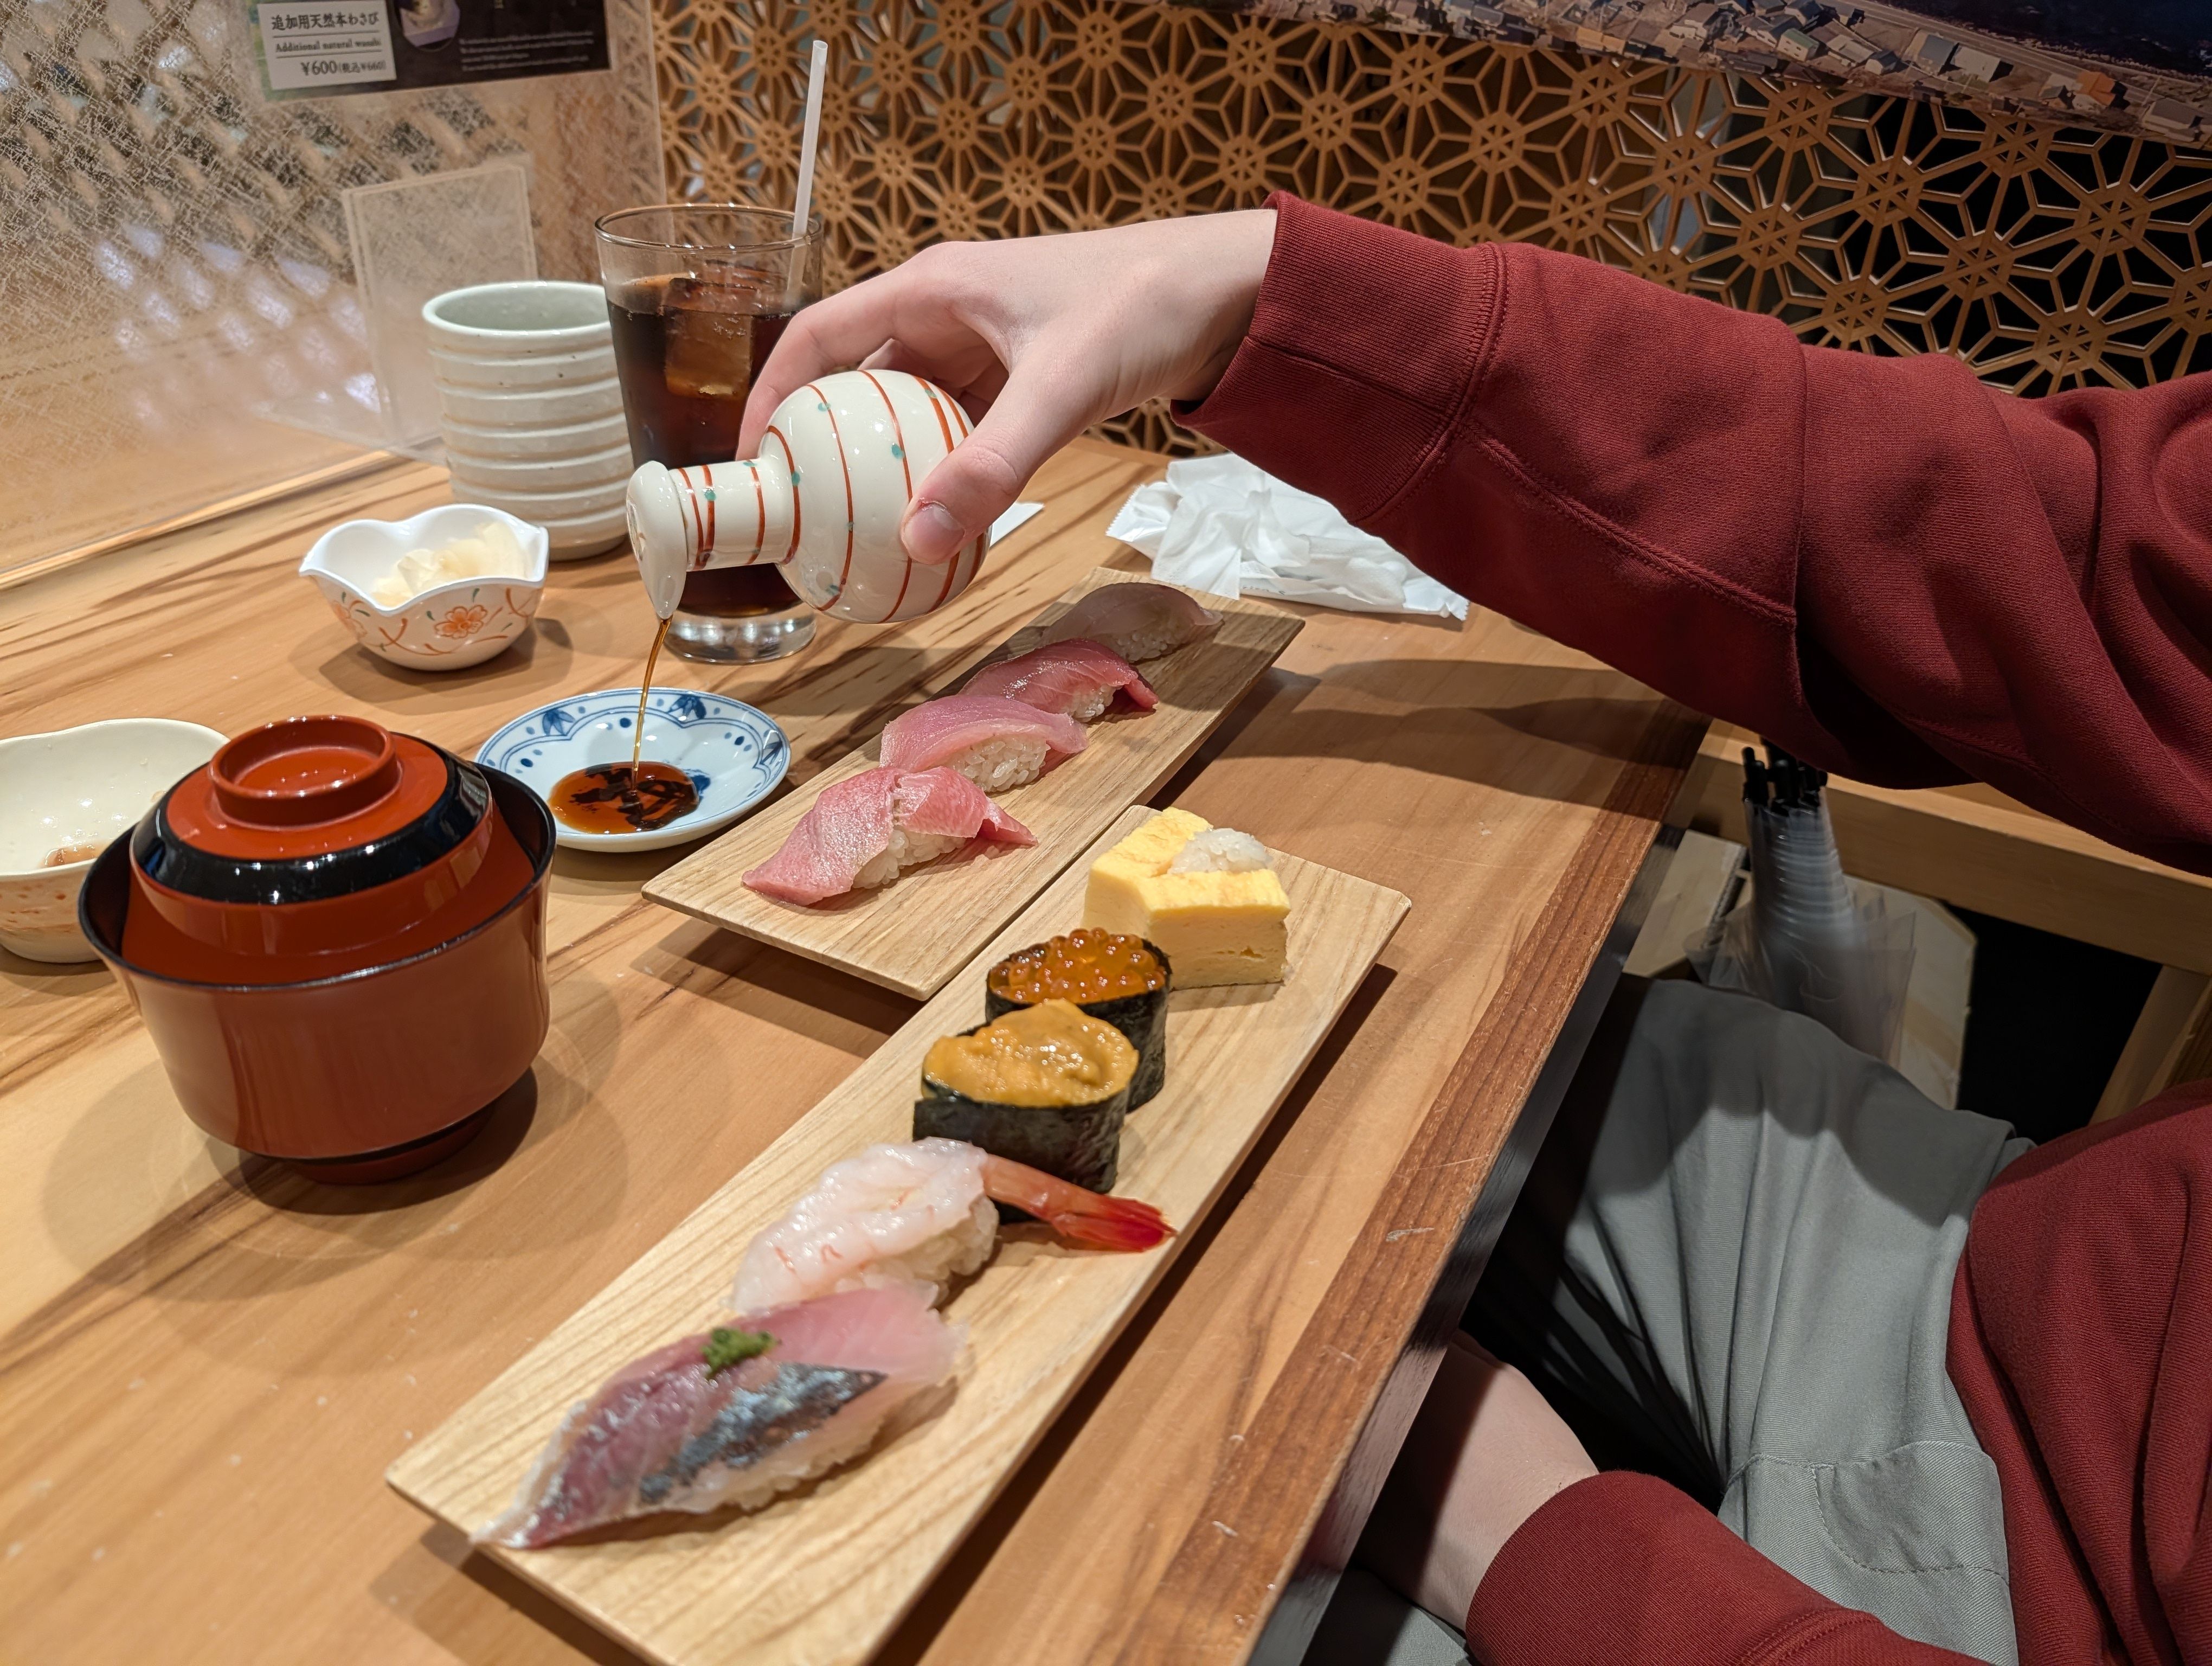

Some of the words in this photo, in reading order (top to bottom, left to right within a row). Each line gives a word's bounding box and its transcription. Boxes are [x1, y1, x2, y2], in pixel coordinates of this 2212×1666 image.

[271, 11, 379, 30] 追加用天然本わさび
[276, 40, 320, 52] Additional
[323, 38, 352, 49] natural
